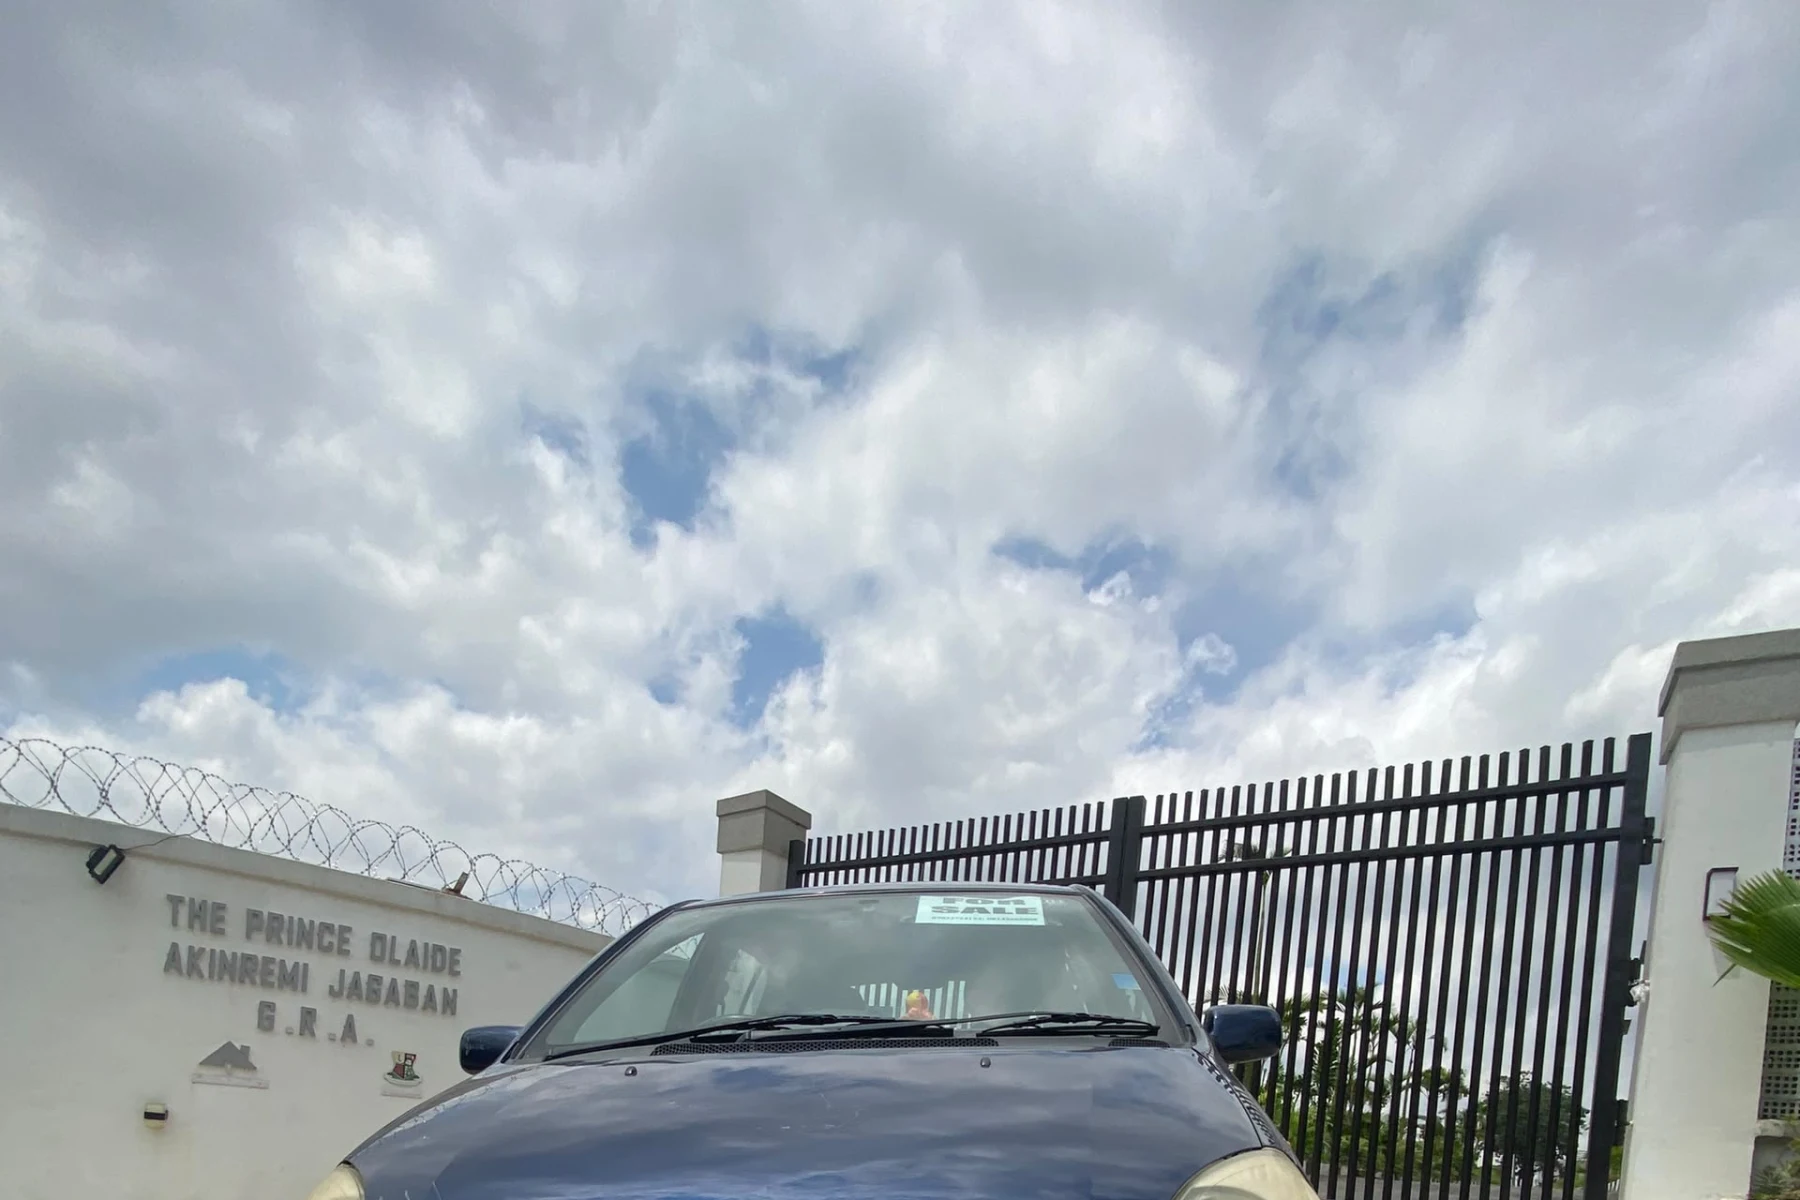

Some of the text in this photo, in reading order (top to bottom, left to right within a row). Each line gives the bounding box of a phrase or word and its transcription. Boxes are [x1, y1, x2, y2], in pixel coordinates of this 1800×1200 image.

[166, 893, 462, 977] THE PRINCE OLAIDE
[931, 906, 1039, 915] SALE
[163, 941, 458, 1016] AKINREMI JAGABAN
